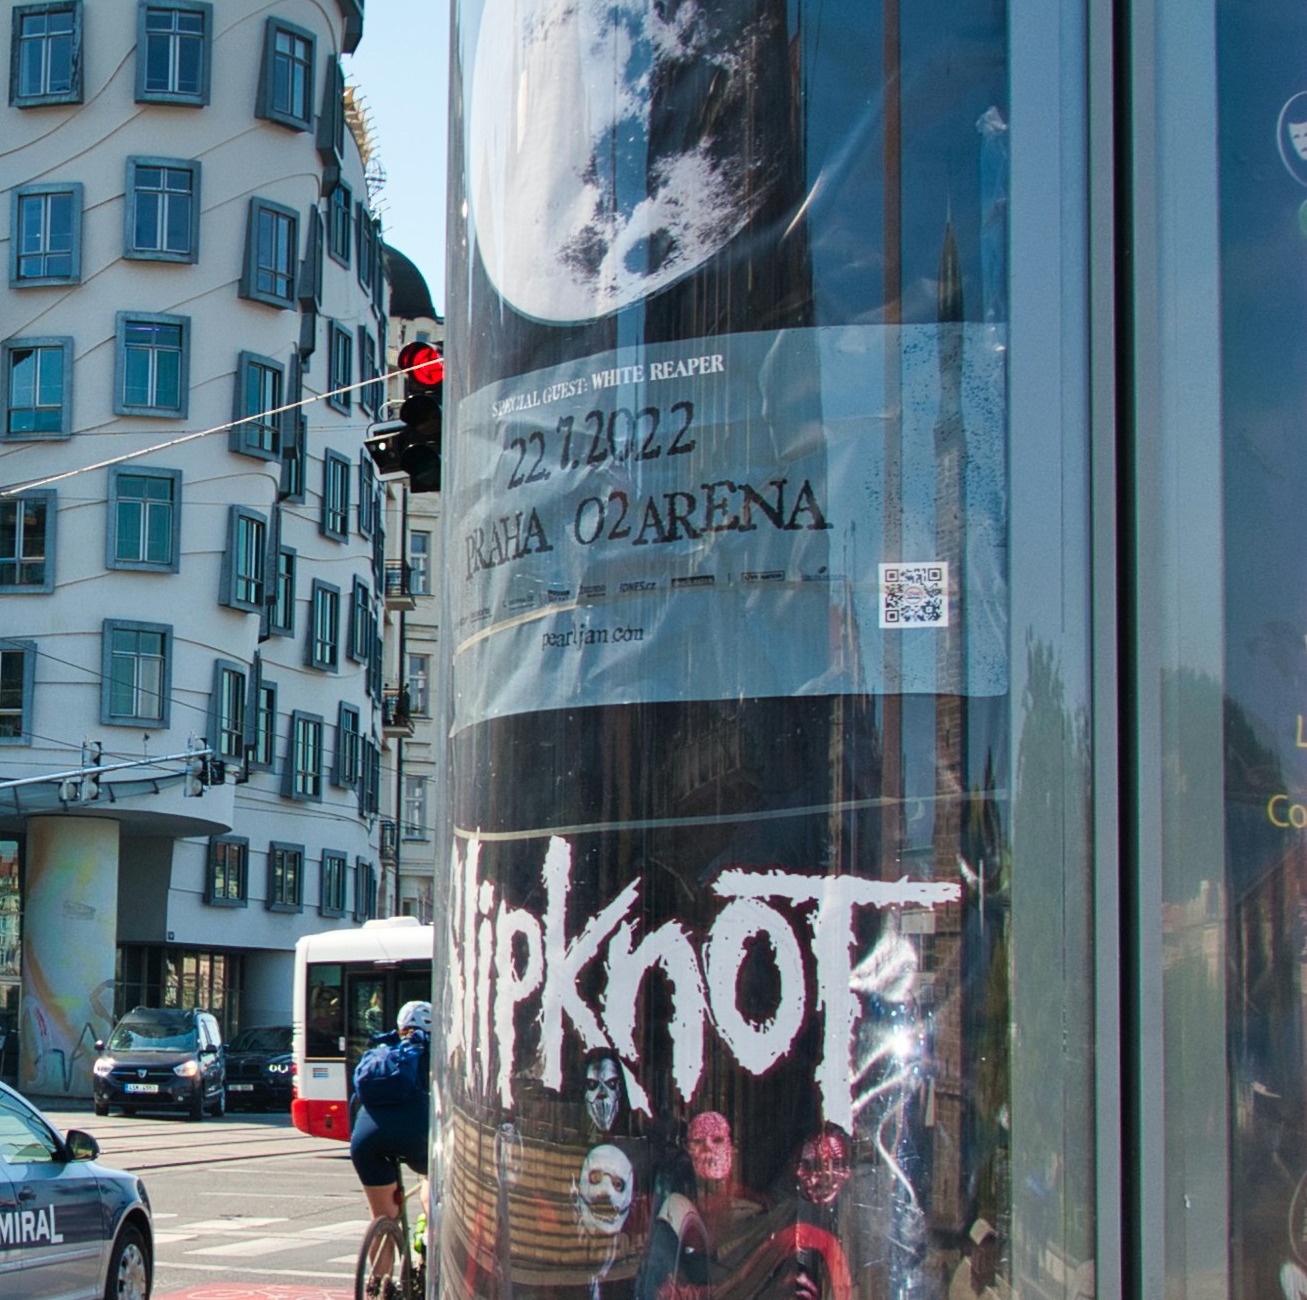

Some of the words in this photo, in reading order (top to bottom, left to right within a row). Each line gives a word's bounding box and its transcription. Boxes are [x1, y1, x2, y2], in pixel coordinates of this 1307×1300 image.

[492, 387, 541, 418] SPECIAL
[591, 364, 644, 390] WHITE
[649, 353, 725, 381] REAPER
[464, 505, 554, 581] PRAHA
